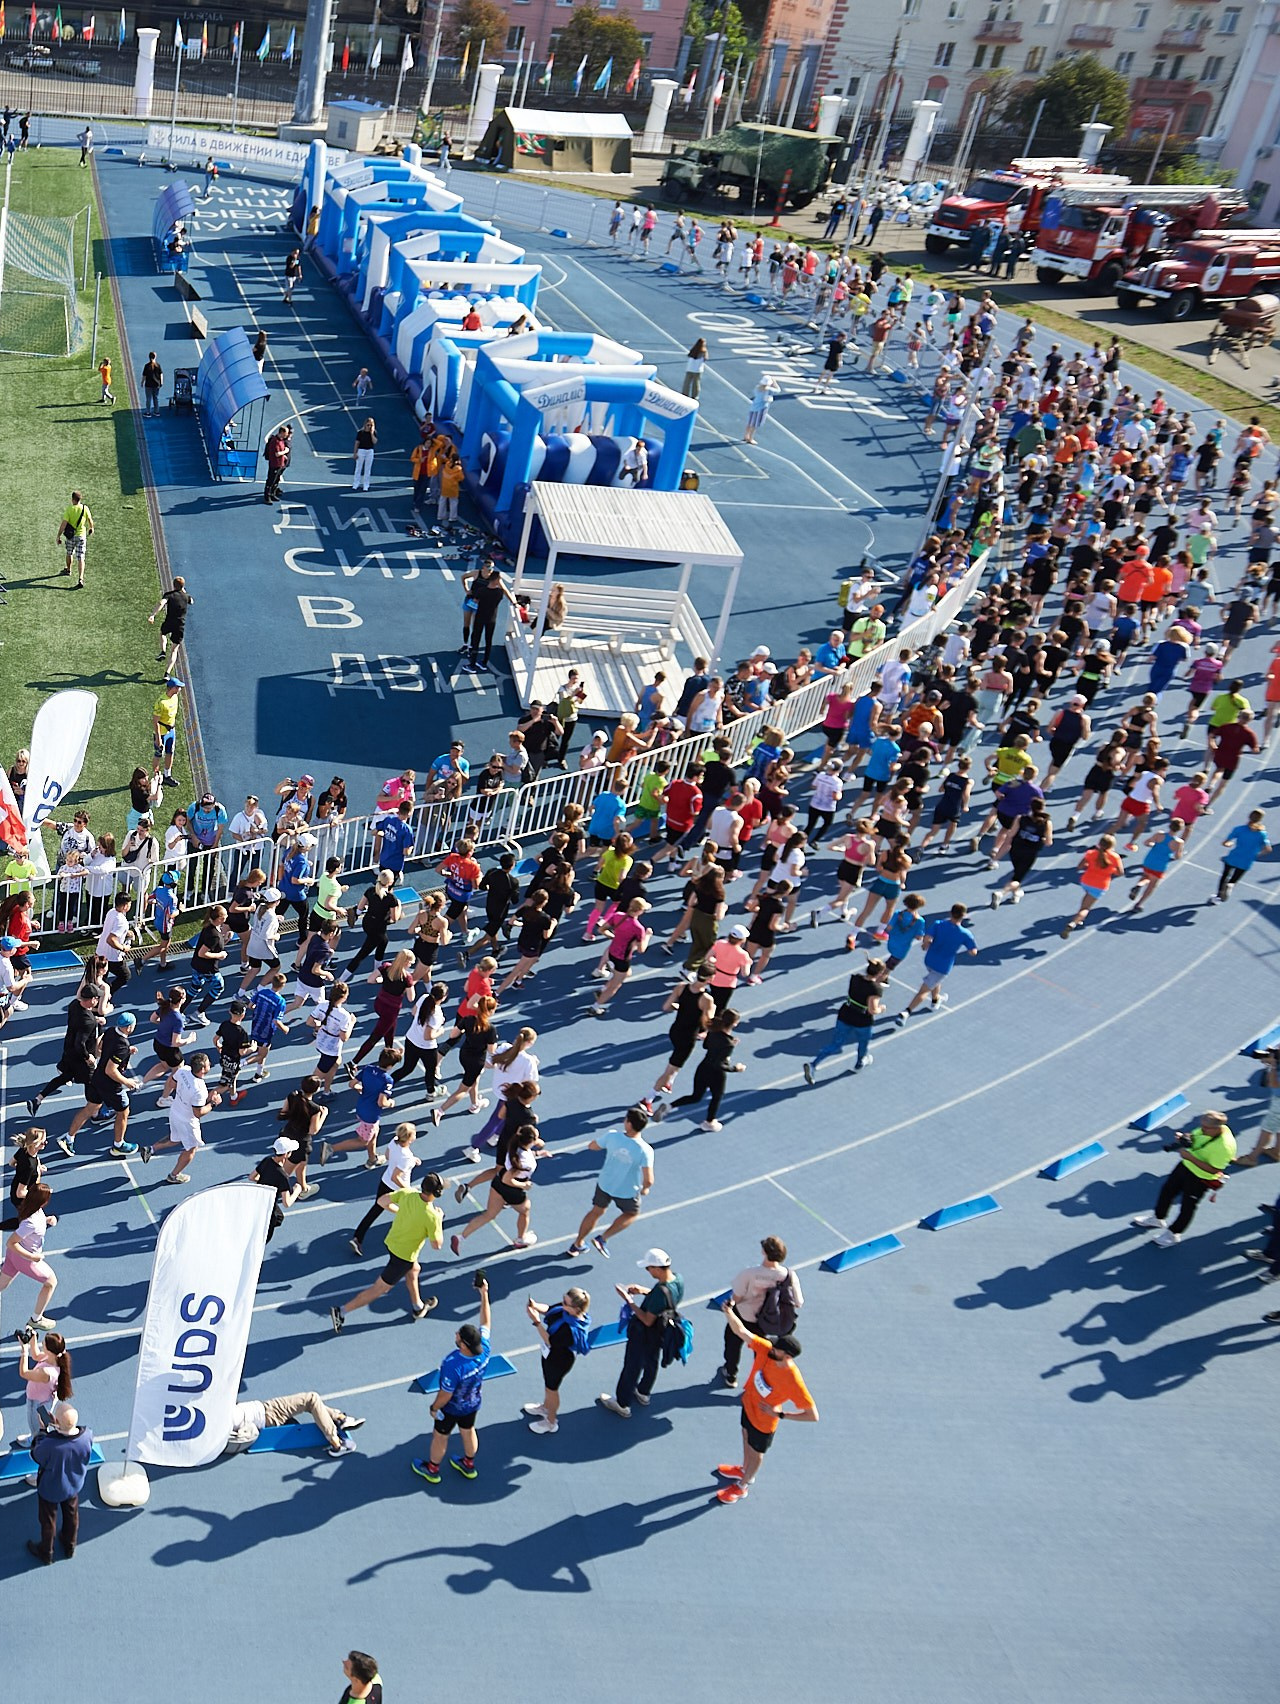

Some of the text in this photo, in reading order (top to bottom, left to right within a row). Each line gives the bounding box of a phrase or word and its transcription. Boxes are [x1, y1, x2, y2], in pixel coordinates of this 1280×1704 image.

[167, 133, 196, 146] СИЛА
[200, 138, 206, 147] В
[209, 139, 272, 158] ДВИЖЕНИИ
[275, 149, 282, 159] И
[272, 503, 429, 536] ДИН
[296, 595, 364, 629] В
[167, 1292, 226, 1394] UDS
